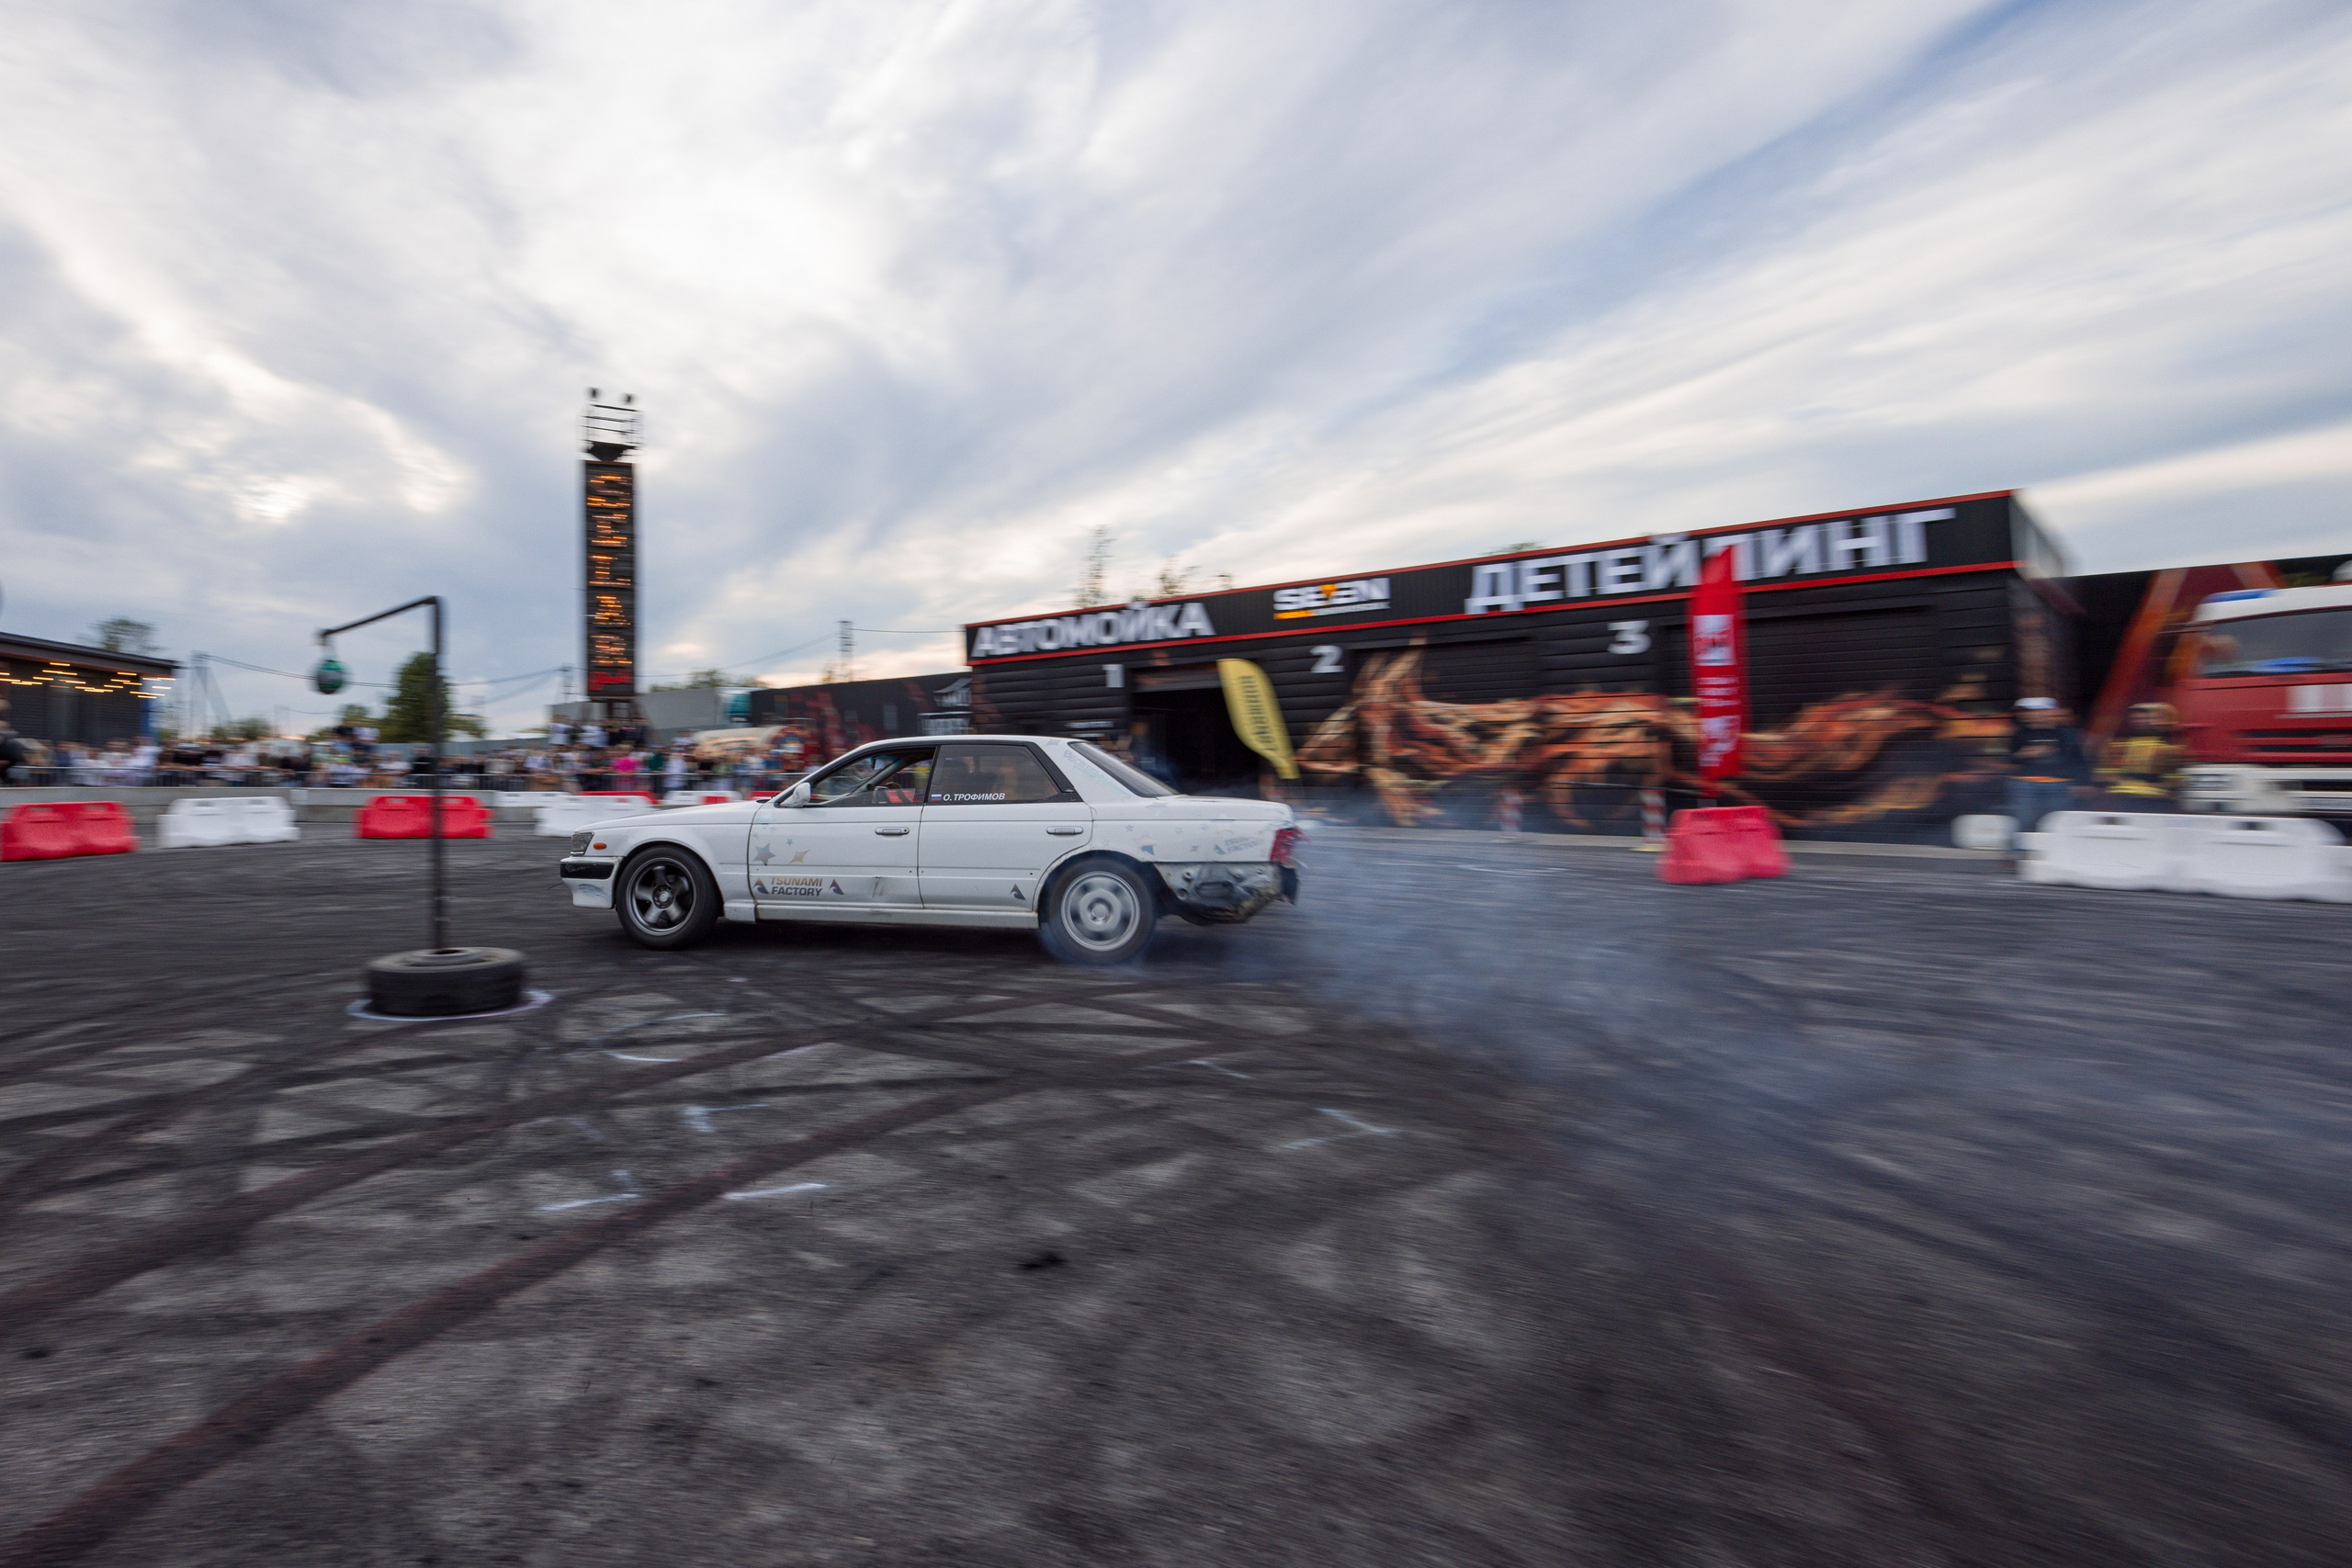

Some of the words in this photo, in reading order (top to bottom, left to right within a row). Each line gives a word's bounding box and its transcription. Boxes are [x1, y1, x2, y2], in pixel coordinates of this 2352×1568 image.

[971, 603, 1216, 658] АВТОМОЙКА
[1607, 620, 1650, 655] 3
[1309, 645, 1343, 673] 2
[1102, 664, 1124, 688] 1
[771, 876, 823, 886] TSUNAMI
[772, 886, 822, 897] FACTORY
